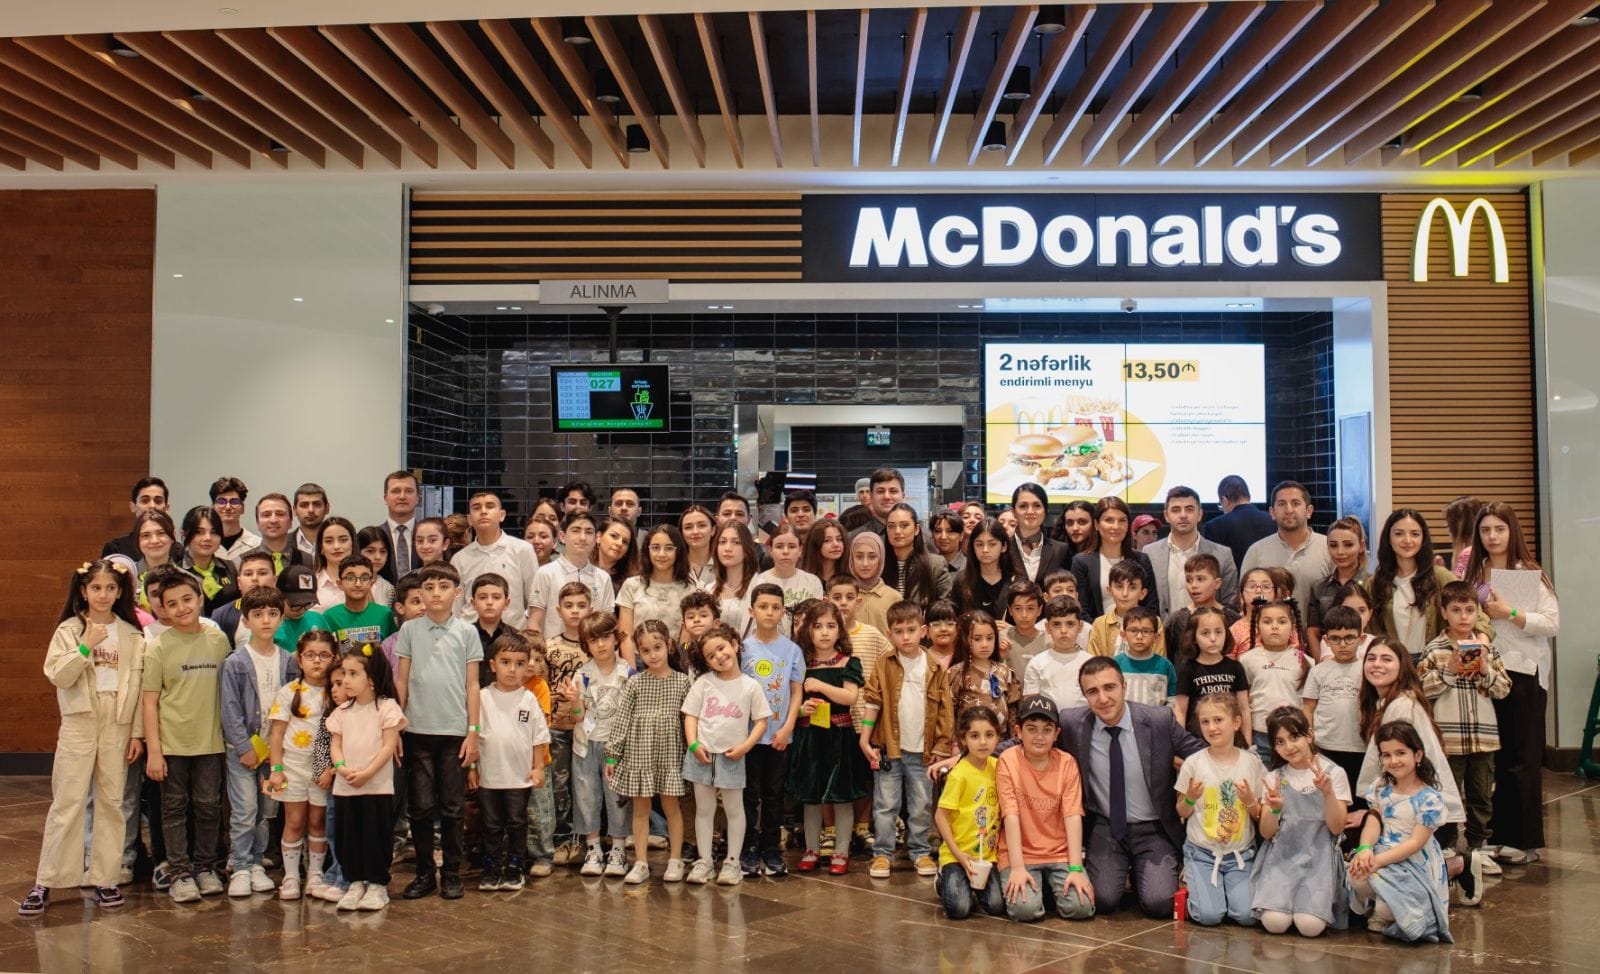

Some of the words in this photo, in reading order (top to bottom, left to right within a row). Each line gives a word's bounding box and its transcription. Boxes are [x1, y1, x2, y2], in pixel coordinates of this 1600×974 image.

[849, 206, 1342, 267] McDonald's
[570, 284, 637, 298] ALINMA
[999, 353, 1013, 371] 2
[1017, 355, 1092, 371] nəfərlik
[590, 379, 614, 389] 027
[1000, 377, 1052, 387] endirimli
[1054, 379, 1093, 389] menyu
[1201, 684, 1231, 695] ABOUT
